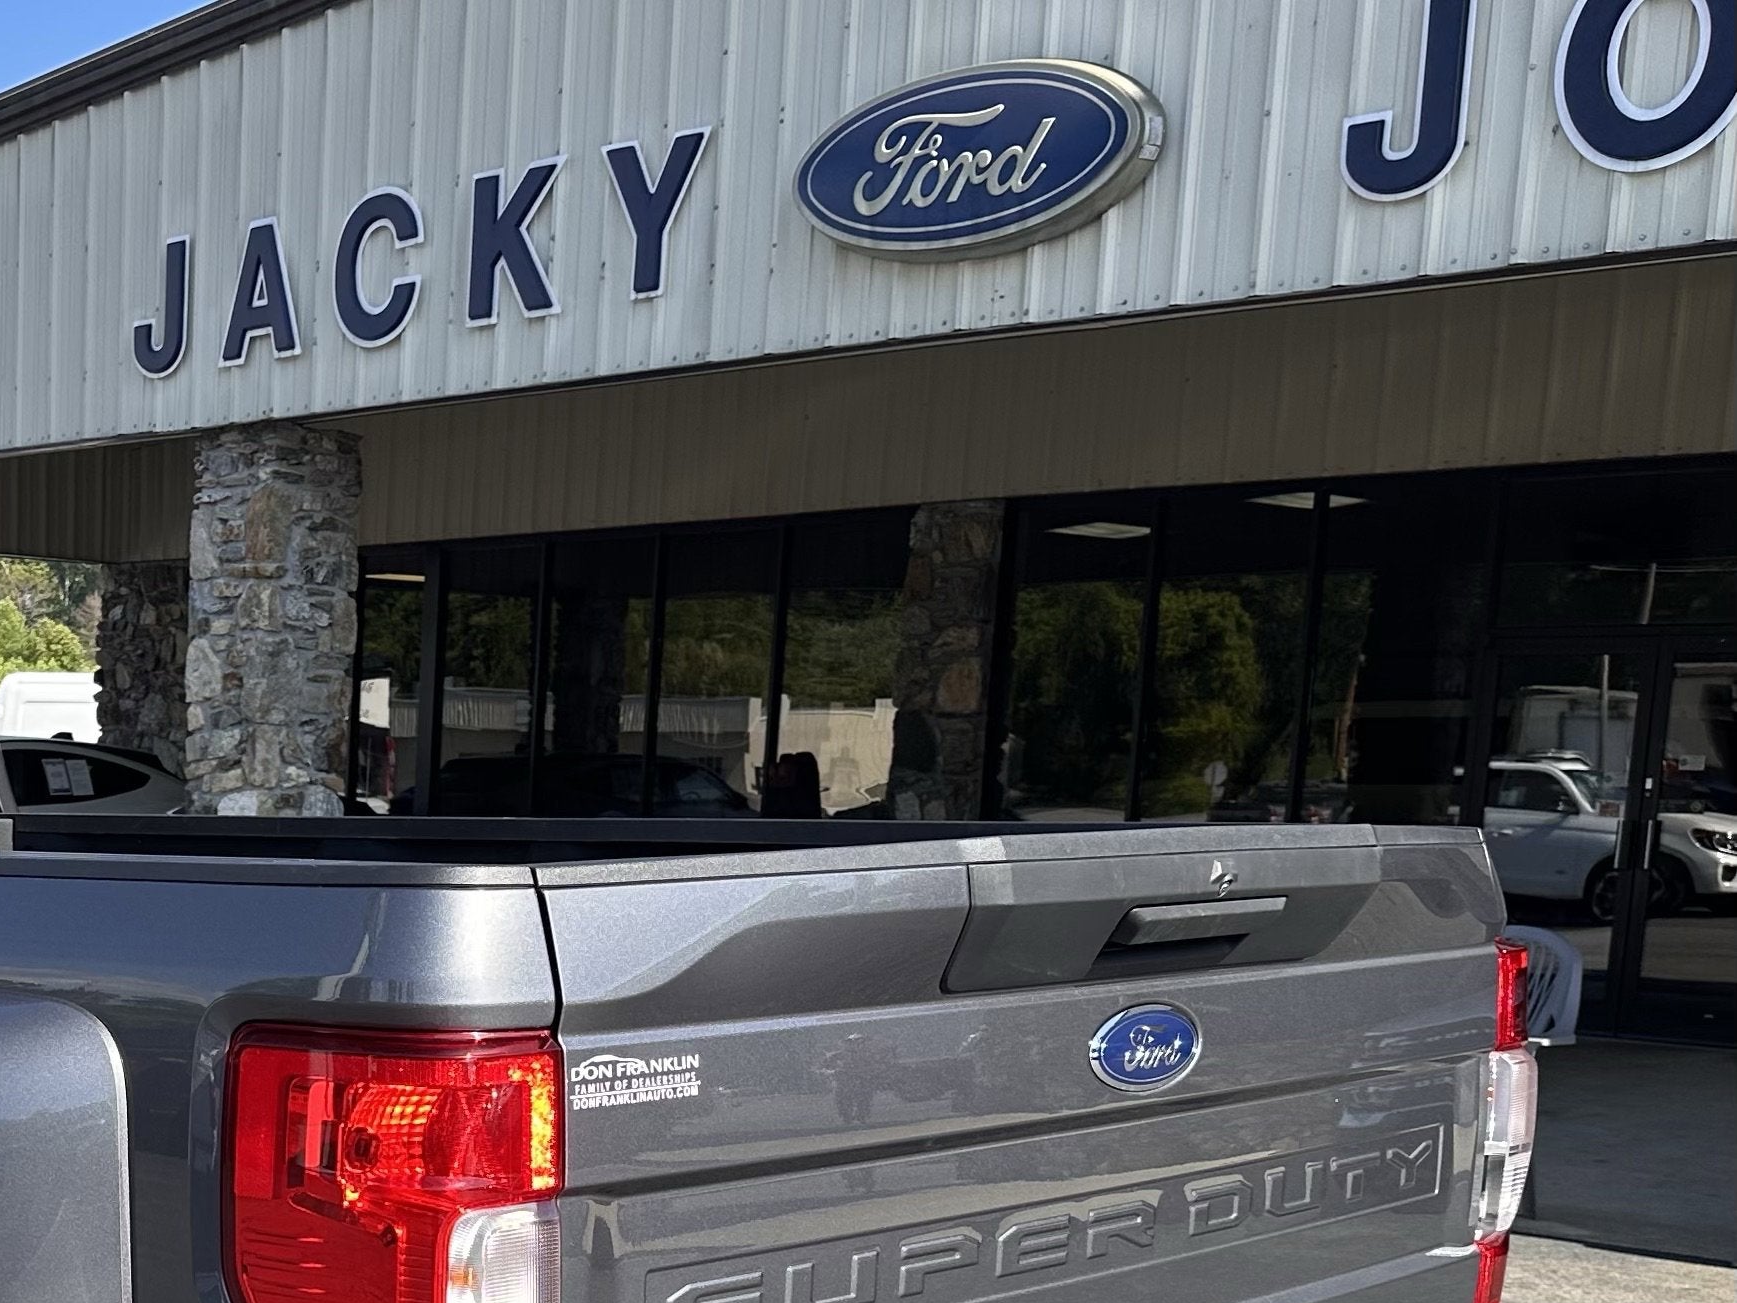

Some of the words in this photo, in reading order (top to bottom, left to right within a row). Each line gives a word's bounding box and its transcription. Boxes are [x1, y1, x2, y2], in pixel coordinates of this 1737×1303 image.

[853, 103, 1056, 216] Ford
[133, 126, 712, 379] JACKY
[570, 1063, 613, 1082] DON
[616, 1054, 700, 1078] FRANKLIN
[1123, 1024, 1183, 1072] Ford
[573, 1085, 700, 1110] DONFRANKLINAUTO.COM
[574, 1081, 611, 1096] FAMILY
[614, 1079, 629, 1091] OF
[631, 1071, 697, 1089] DEALERSHIPS
[1188, 1139, 1433, 1236] DUTY
